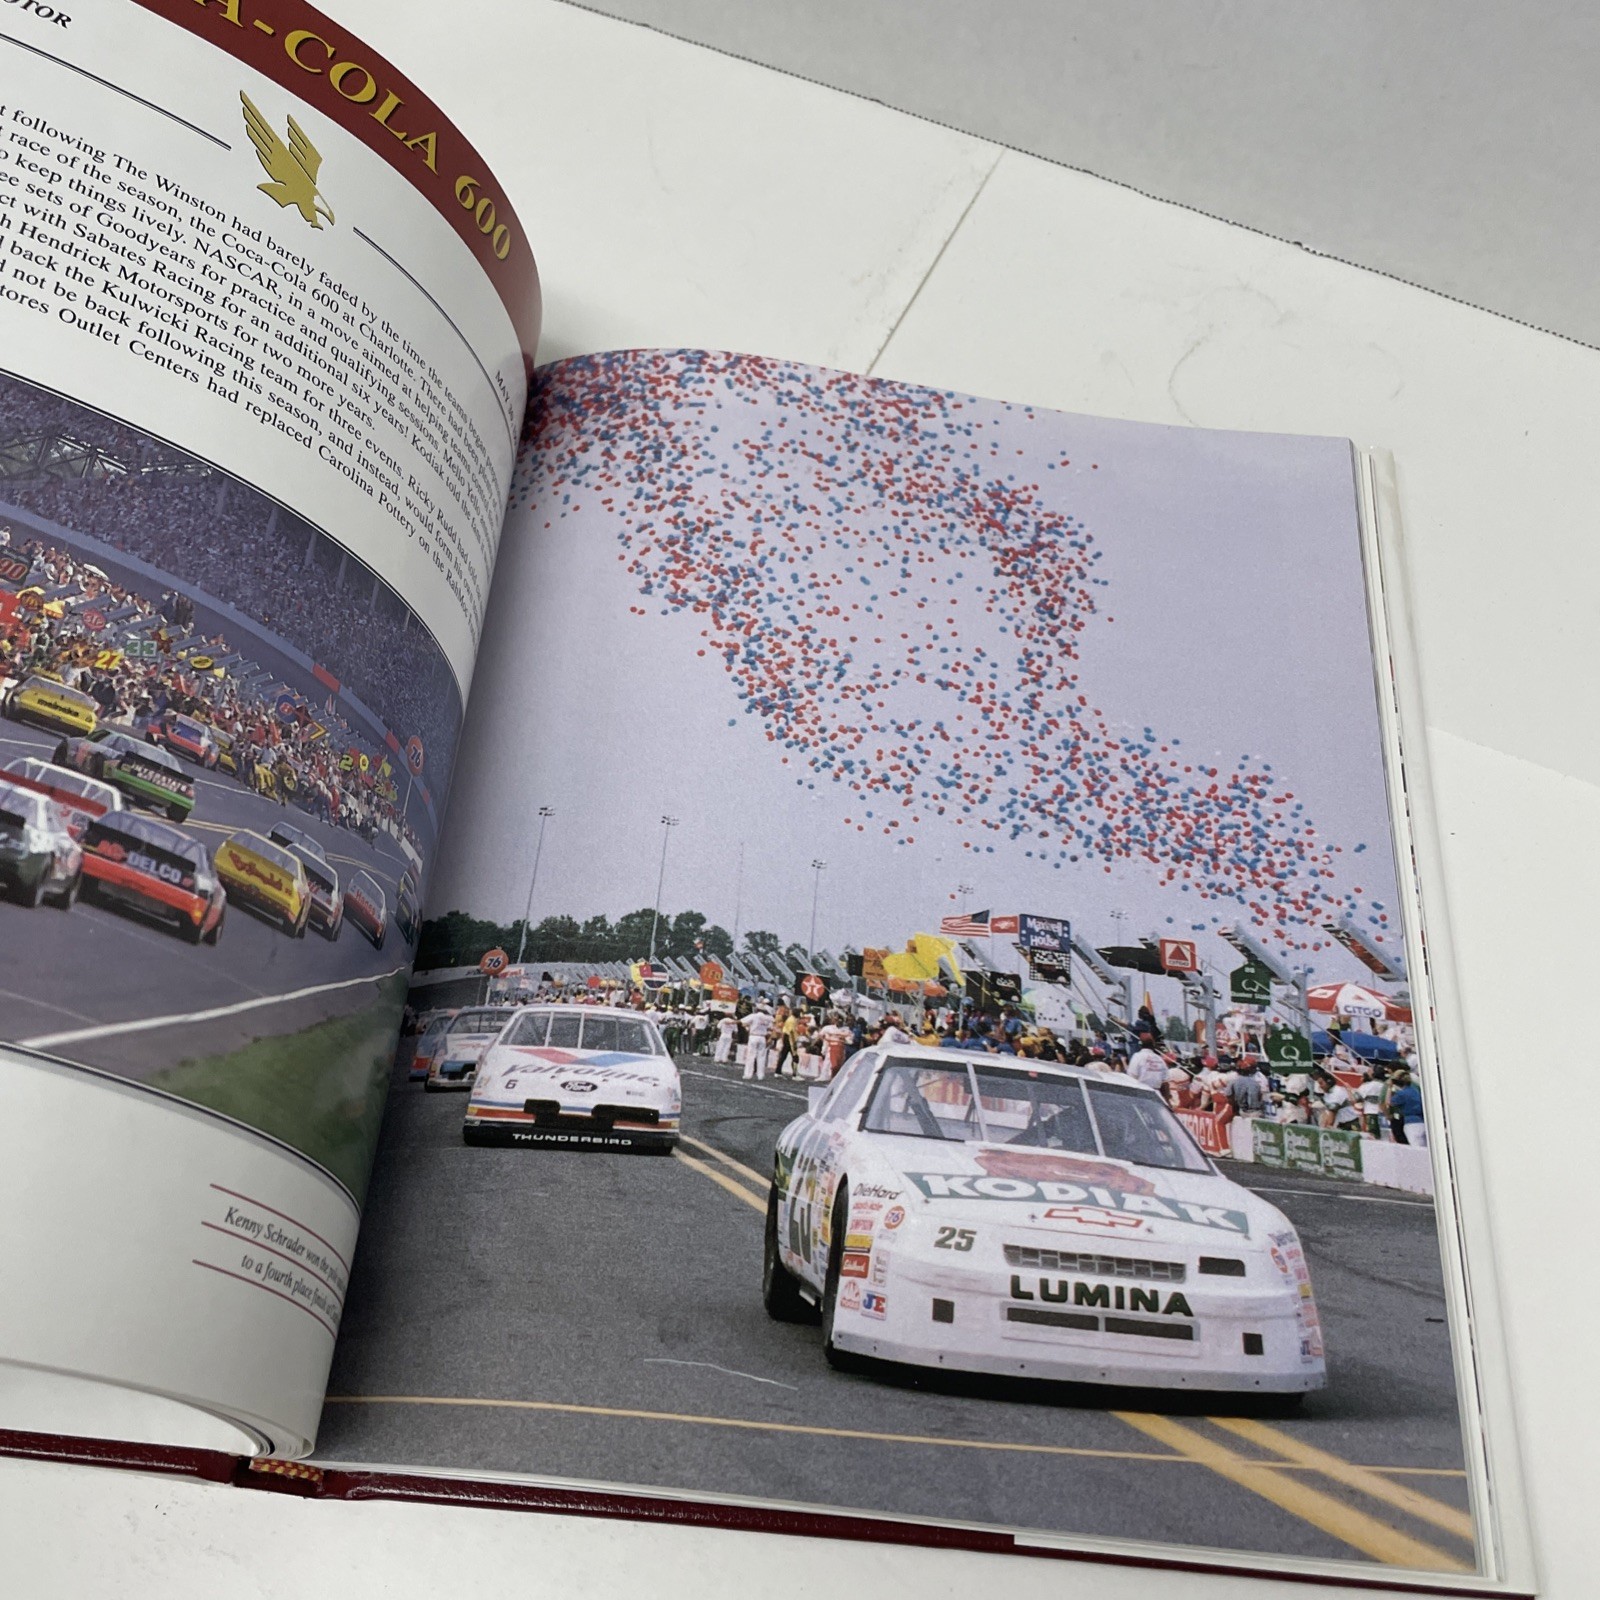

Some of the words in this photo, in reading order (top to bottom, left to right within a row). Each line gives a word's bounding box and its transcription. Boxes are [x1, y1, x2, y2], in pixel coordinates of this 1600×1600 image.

[3, 0, 72, 30] TOR
[454, 175, 511, 260] 600
[12, 110, 106, 163] following
[114, 154, 147, 180] The
[156, 174, 225, 223] Winston
[231, 216, 262, 242] had
[267, 236, 314, 276] barely
[319, 272, 358, 307] faded
[362, 302, 377, 324] by
[382, 321, 399, 342] the
[403, 340, 425, 369] time
[429, 367, 442, 389] the
[9, 133, 50, 156] race
[57, 154, 80, 168] of
[83, 164, 111, 184] the
[117, 182, 182, 222] season,
[190, 216, 215, 237] the
[222, 233, 306, 292] Coca-Cola
[312, 289, 339, 313] 600
[343, 312, 355, 327] at
[360, 323, 415, 381] Charlotte.
[420, 376, 446, 415] There
[448, 411, 463, 438] had
[15, 153, 62, 184] keep
[69, 178, 126, 212] things
[132, 206, 186, 244] lively.
[193, 237, 282, 299] NASCAR,
[288, 292, 302, 310] in
[307, 308, 315, 319] a
[320, 317, 358, 350] move
[362, 348, 399, 385] aimed
[402, 384, 411, 398] at
[415, 393, 449, 443] helping
[19, 222, 111, 272] Hendrick
[117, 265, 228, 330] Motorsports
[233, 325, 258, 346] for
[263, 343, 292, 367] two
[297, 366, 334, 396] more
[337, 394, 375, 430] years.
[24, 204, 66, 230] with
[73, 223, 146, 266] Sabates
[152, 260, 216, 304] Racing
[221, 296, 246, 318] for
[251, 316, 269, 333] an
[275, 330, 348, 386] additional
[352, 383, 370, 404] six
[373, 401, 408, 438] years!
[411, 434, 444, 480] Kodiak
[446, 477, 461, 502] told
[461, 500, 470, 520] the
[25, 184, 63, 205] sets
[70, 203, 93, 218] of
[97, 213, 195, 269] Goodyears
[201, 264, 227, 285] for
[230, 283, 295, 326] practice
[300, 324, 327, 348] and
[331, 346, 396, 407] qualifying
[399, 402, 440, 453] sessions.
[443, 449, 465, 486] Mello
[467, 482, 480, 516] Yello
[10, 241, 58, 271] back
[65, 266, 94, 286] the
[101, 280, 189, 332] Kulwicki
[194, 325, 255, 371] Racing
[261, 363, 297, 395] team
[303, 389, 325, 411] for
[329, 408, 361, 440] three
[366, 439, 404, 479] events.
[408, 474, 435, 514] Ricky
[437, 508, 457, 544] Rudd
[457, 538, 468, 564] had
[12, 269, 46, 289] not
[54, 282, 77, 301] be
[85, 295, 131, 327] back
[137, 321, 226, 377] following
[233, 370, 262, 394] this
[268, 392, 322, 436] season,
[328, 432, 353, 456] and
[357, 450, 400, 501] instead,
[406, 497, 433, 534] would
[435, 530, 452, 562] form
[59, 308, 120, 345] Outlet
[129, 340, 199, 383] Centers
[207, 377, 239, 403] had
[245, 401, 312, 448] replaced
[319, 445, 373, 496] Carolina
[378, 491, 416, 537] Pottery
[419, 536, 429, 554] on
[433, 551, 444, 572] the
[96, 651, 121, 669] 27
[128, 850, 182, 883] DELCO
[1026, 917, 1063, 937] Maxwell
[1030, 933, 1060, 948] House
[487, 956, 503, 969] 76
[1343, 1005, 1382, 1018] CITGO
[500, 1063, 660, 1086] Valvoline
[505, 1079, 518, 1090] 6
[564, 1080, 593, 1092] Ford
[512, 1132, 632, 1146] THUNDERBIRD
[852, 1182, 903, 1200] DieHard
[922, 1174, 1241, 1230] KODIAK
[224, 1206, 263, 1238] Kenny
[264, 1223, 305, 1256] Schrader
[306, 1249, 320, 1267] won
[934, 1226, 977, 1252] 25
[241, 1255, 254, 1270] to
[255, 1262, 263, 1274] a
[262, 1261, 292, 1288] fourth
[291, 1278, 313, 1300] place
[1010, 1274, 1194, 1318] LUMINA
